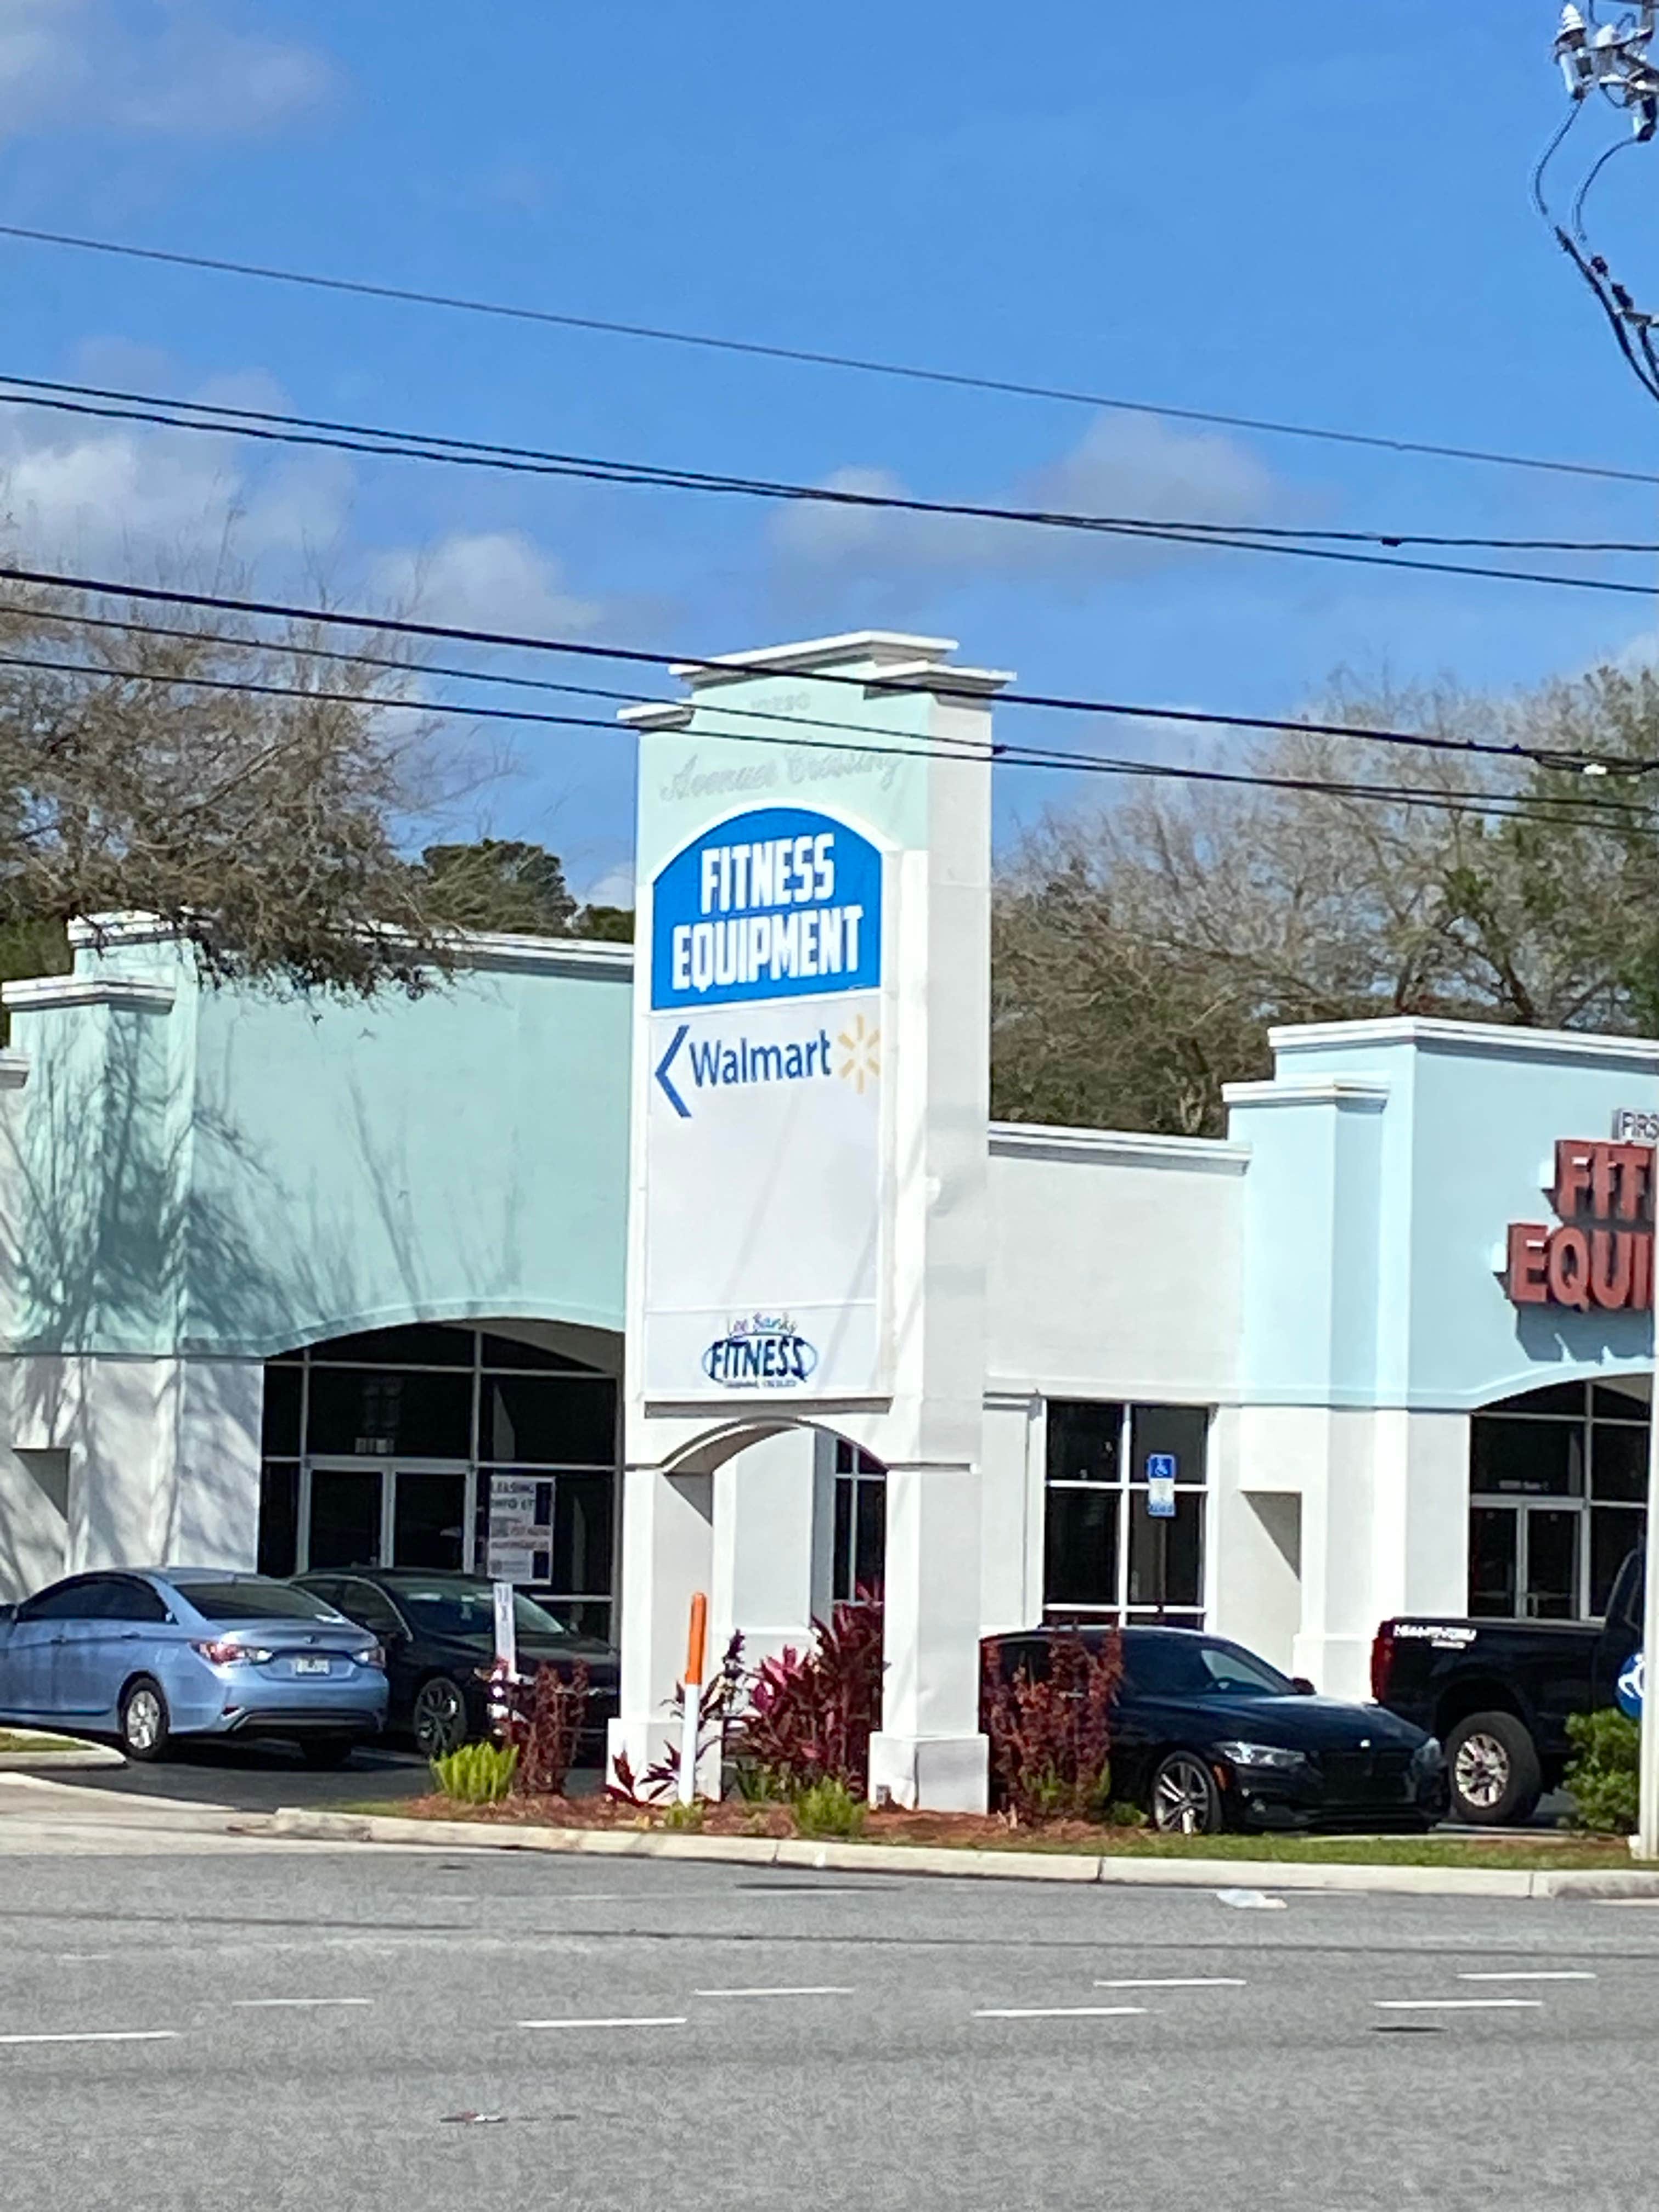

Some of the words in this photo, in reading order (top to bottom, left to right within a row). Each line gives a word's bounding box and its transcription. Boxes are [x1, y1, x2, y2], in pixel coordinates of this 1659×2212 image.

[701, 832, 836, 916] FITNESS
[672, 905, 864, 994] EQUIPMENT
[689, 1029, 832, 1088] Walmart
[709, 1335, 807, 1379] FITNESS
